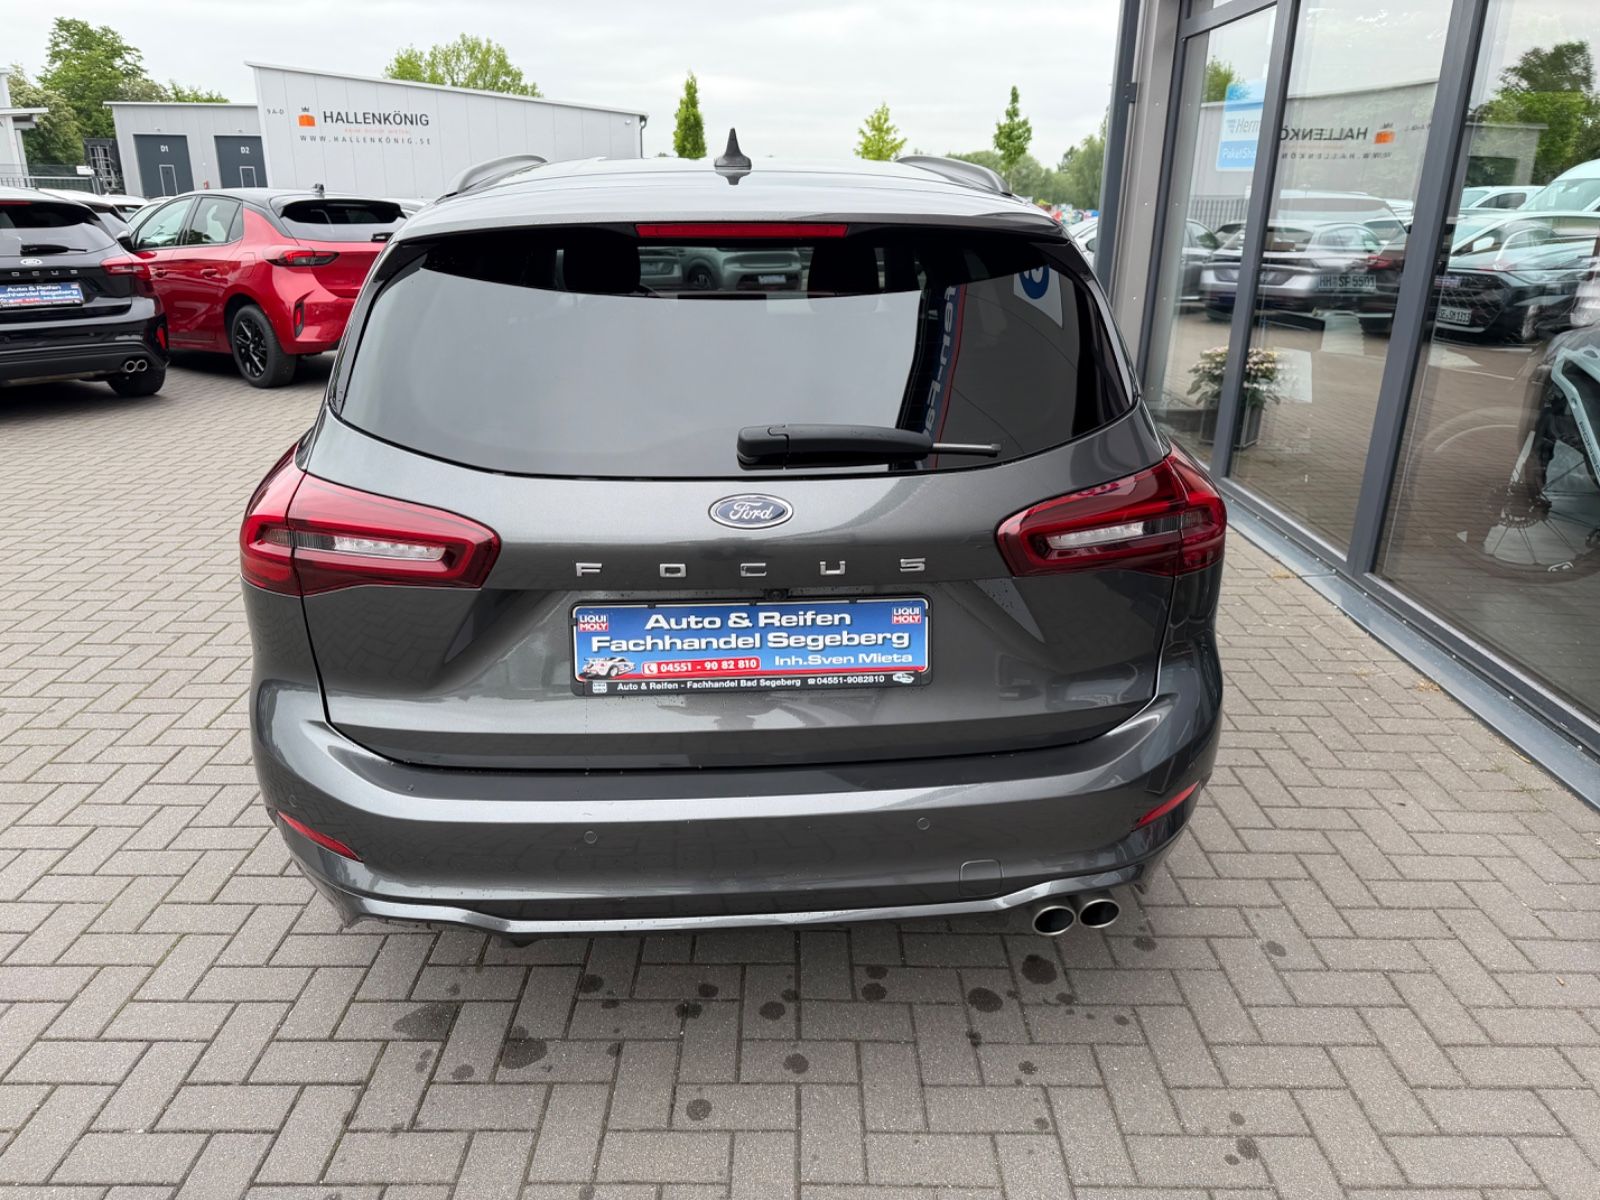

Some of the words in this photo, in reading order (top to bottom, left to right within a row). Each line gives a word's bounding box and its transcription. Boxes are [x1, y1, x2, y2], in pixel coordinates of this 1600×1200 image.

[323, 110, 429, 126] HALLENKÖNIG
[729, 502, 774, 519] Ford
[575, 558, 926, 578] FOCUS
[893, 607, 920, 615] LIQUI
[579, 615, 607, 623] LIQUI
[645, 614, 721, 629] Auto
[727, 612, 753, 628] &
[758, 611, 851, 627] Reifen
[893, 615, 920, 623] MOLY
[579, 623, 608, 631] MOLY
[592, 633, 761, 652] Fachhandel
[767, 630, 910, 650] Segeberg
[858, 653, 912, 664] Mieta
[660, 663, 692, 672] 04551
[704, 661, 718, 670] 90
[721, 660, 735, 669] 82
[738, 659, 757, 668] 810
[617, 682, 638, 691] Auto
[641, 682, 648, 690] &
[650, 682, 679, 690] Reifen
[687, 680, 738, 689] Fachhandel
[740, 679, 757, 687] Bad
[760, 678, 801, 687] Segeberg
